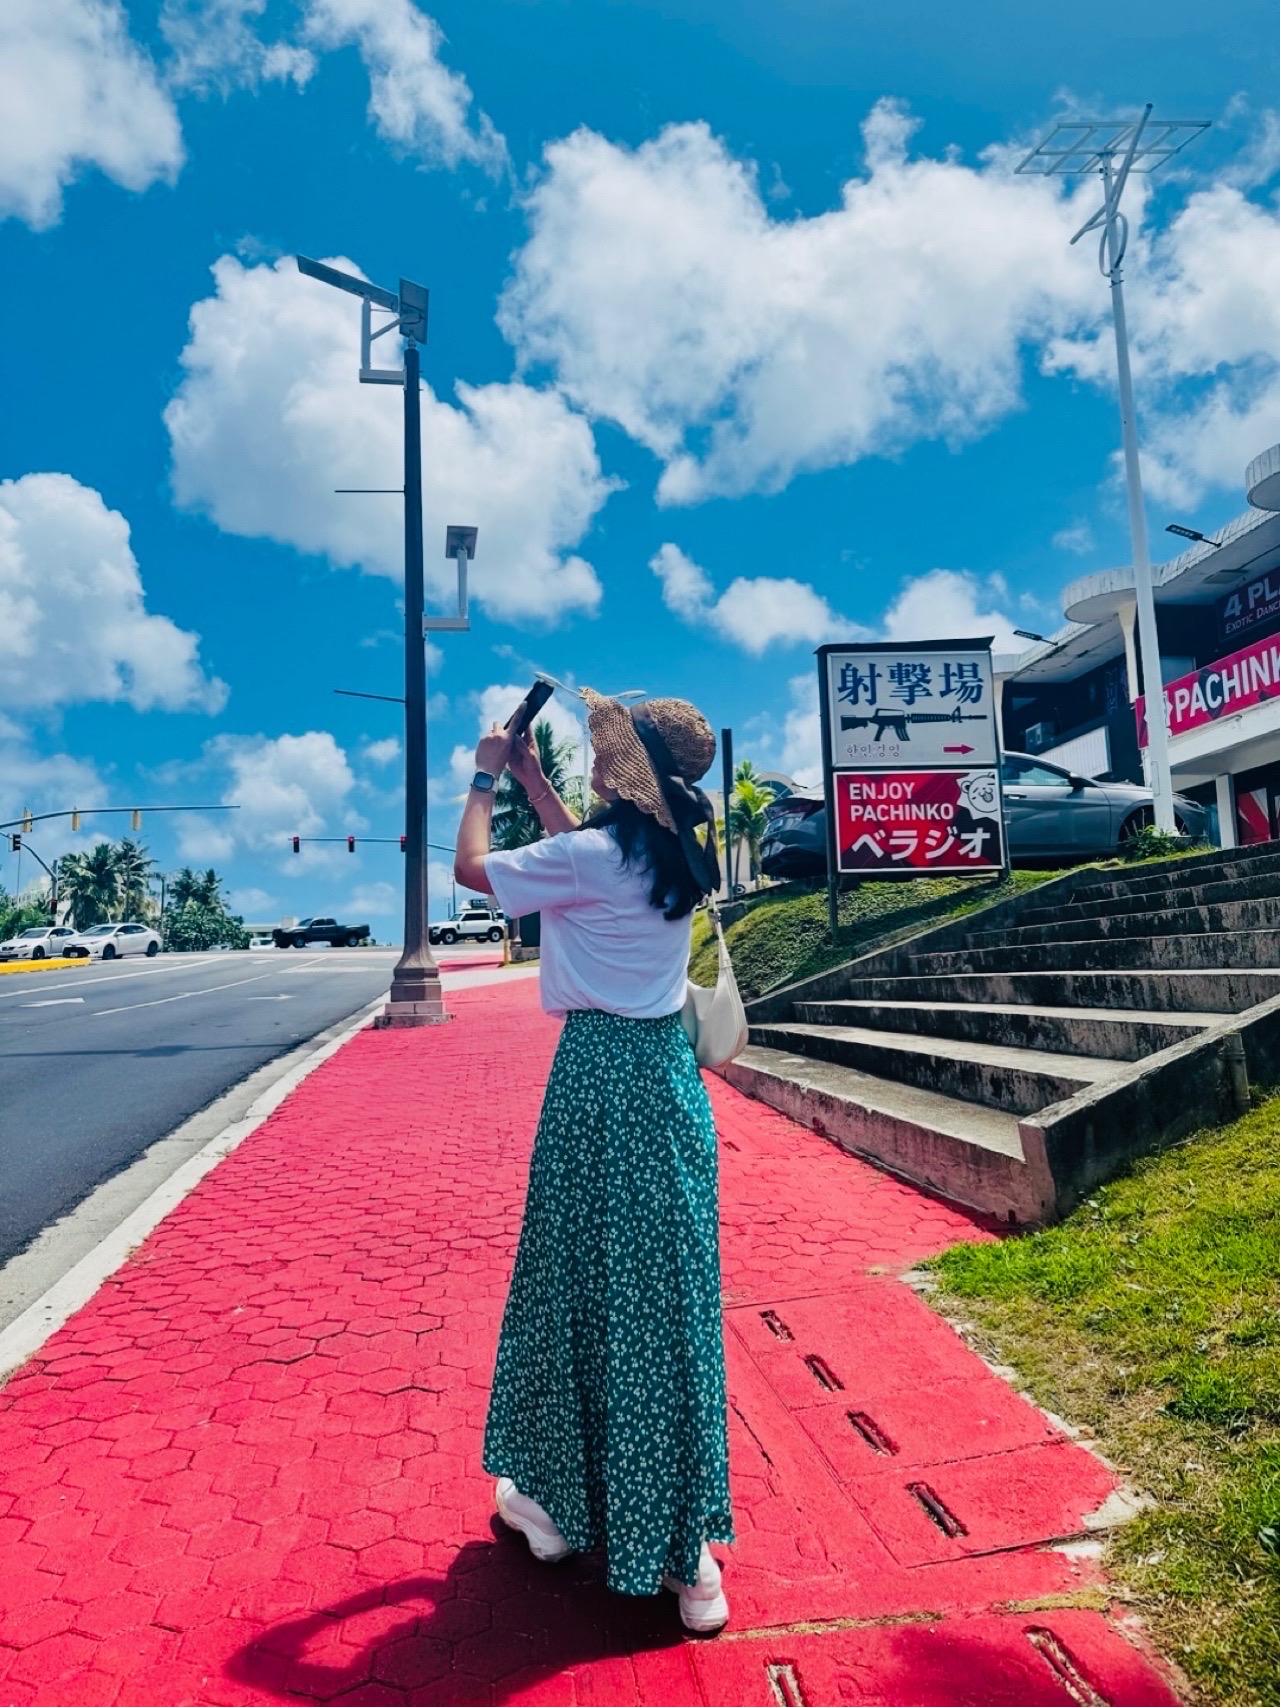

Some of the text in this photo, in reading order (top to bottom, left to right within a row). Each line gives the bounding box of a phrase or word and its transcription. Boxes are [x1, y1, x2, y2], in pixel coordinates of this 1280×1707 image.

[1224, 577, 1280, 618] 4 PL
[1257, 600, 1280, 619] DANC
[837, 662, 984, 706] 射撃場
[849, 782, 915, 801] ENJOY
[850, 803, 954, 822] PACHINKO
[851, 826, 991, 861] ベラジオ
